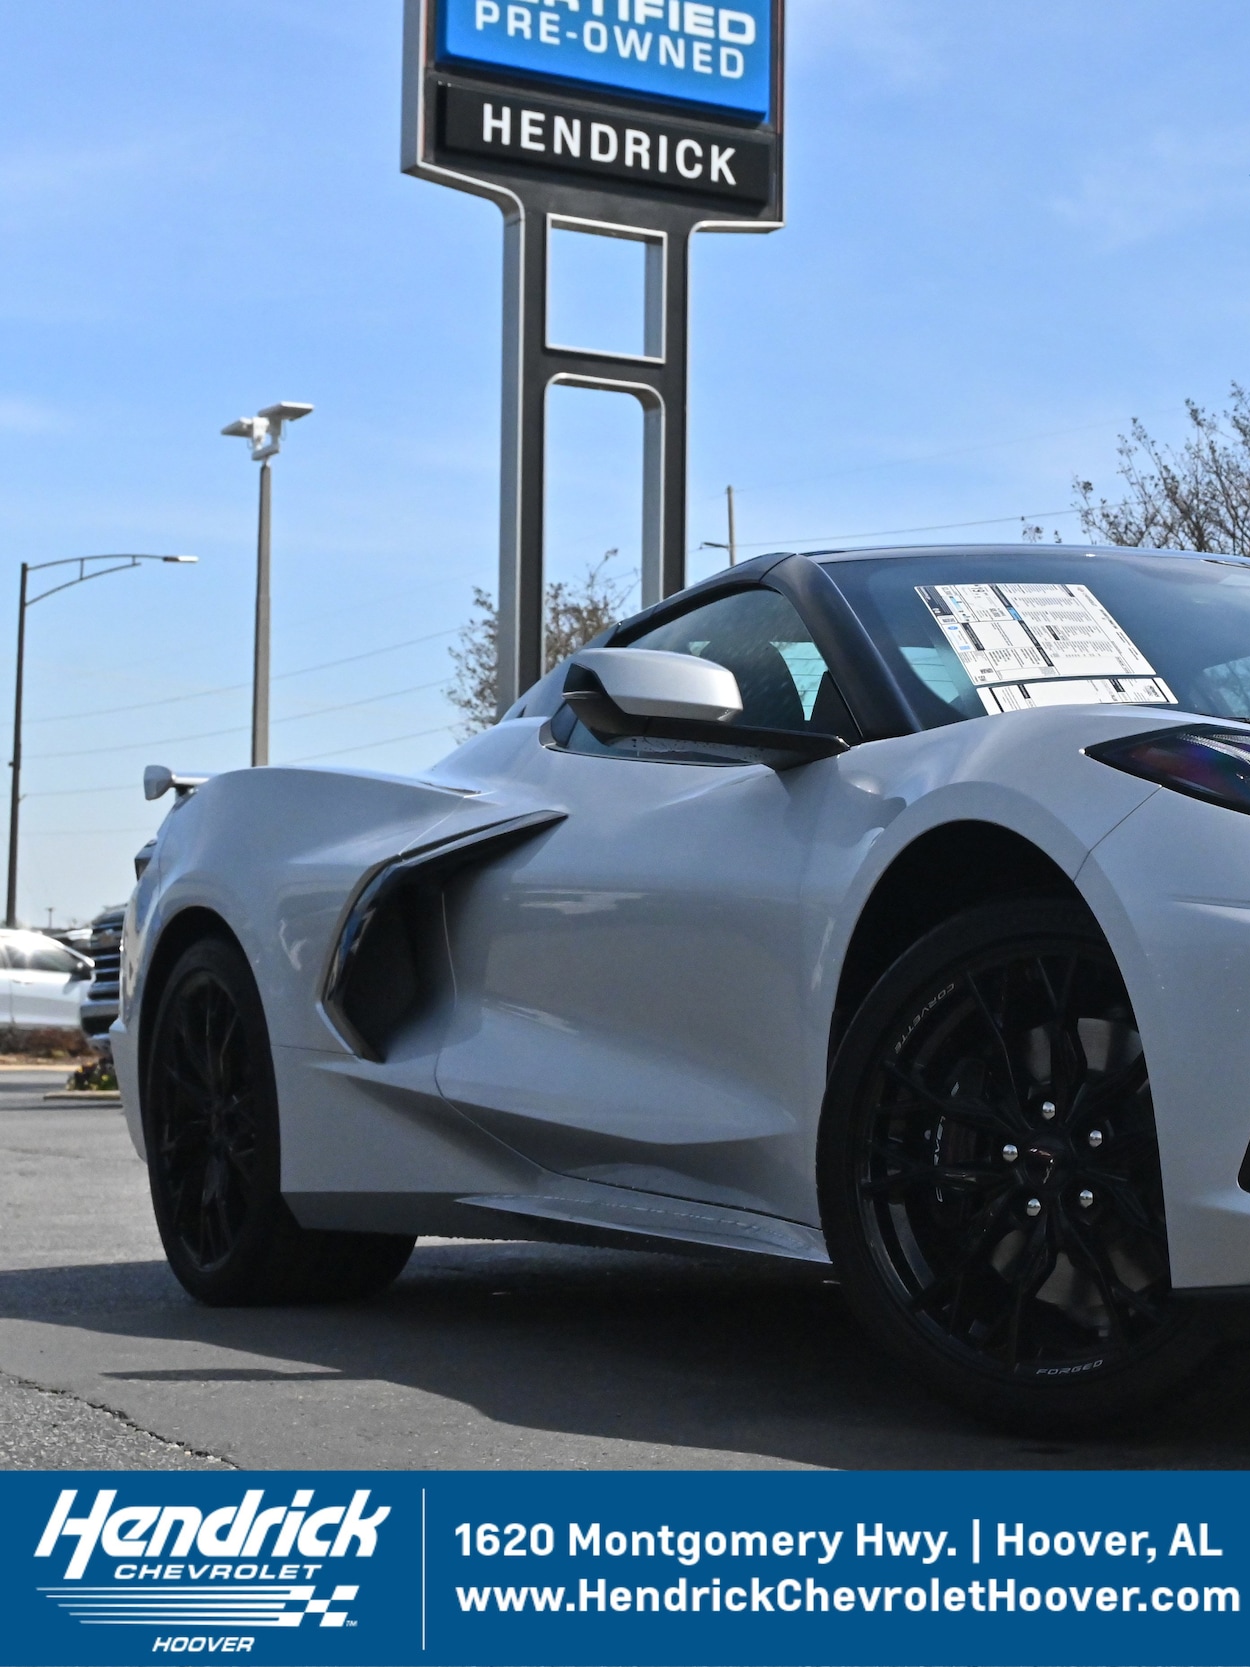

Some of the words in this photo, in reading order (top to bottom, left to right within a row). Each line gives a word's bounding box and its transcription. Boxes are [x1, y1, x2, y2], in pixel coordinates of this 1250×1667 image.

[475, 0, 744, 79] PRE-OWNED
[482, 103, 737, 185] HENDRICK
[894, 983, 955, 1054] CORVETTE
[1036, 1359, 1104, 1375] FORGED
